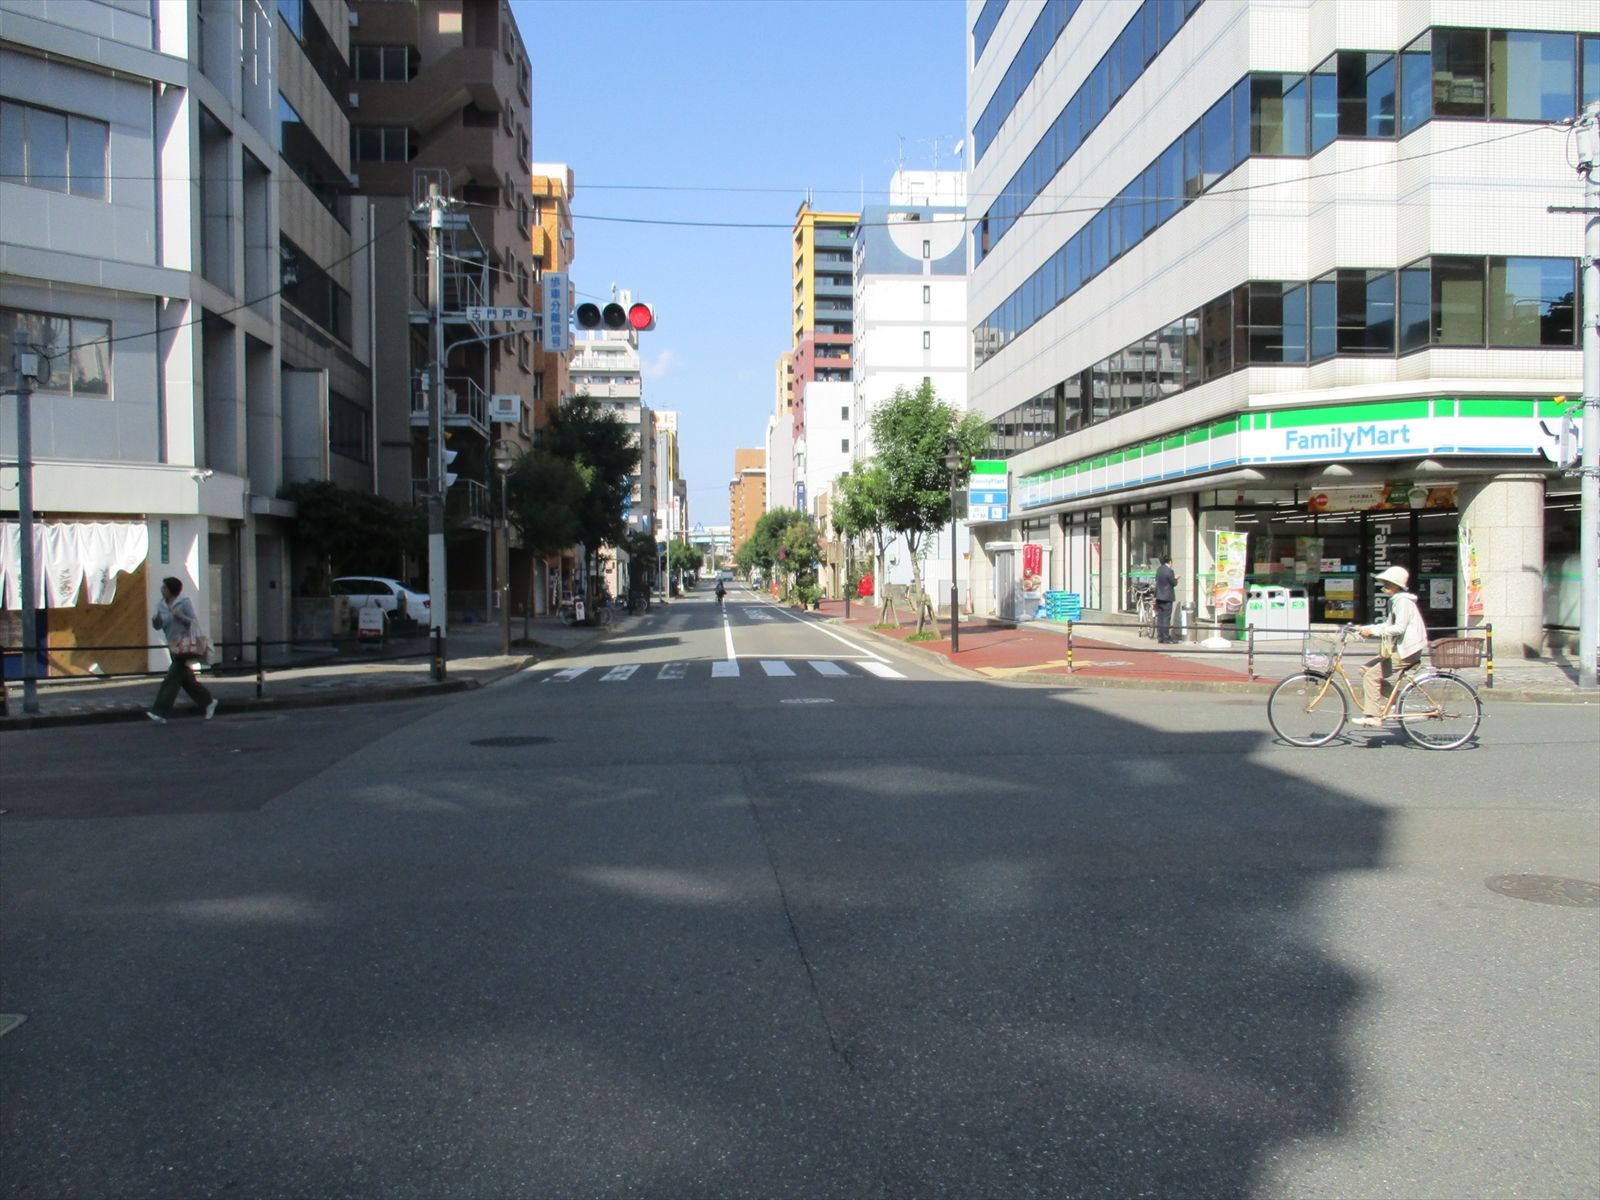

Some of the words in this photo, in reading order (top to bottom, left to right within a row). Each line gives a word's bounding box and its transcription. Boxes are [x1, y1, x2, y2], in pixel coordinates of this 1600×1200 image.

[471, 308, 528, 320] 古門戸町
[1286, 424, 1410, 453] FamilyMart
